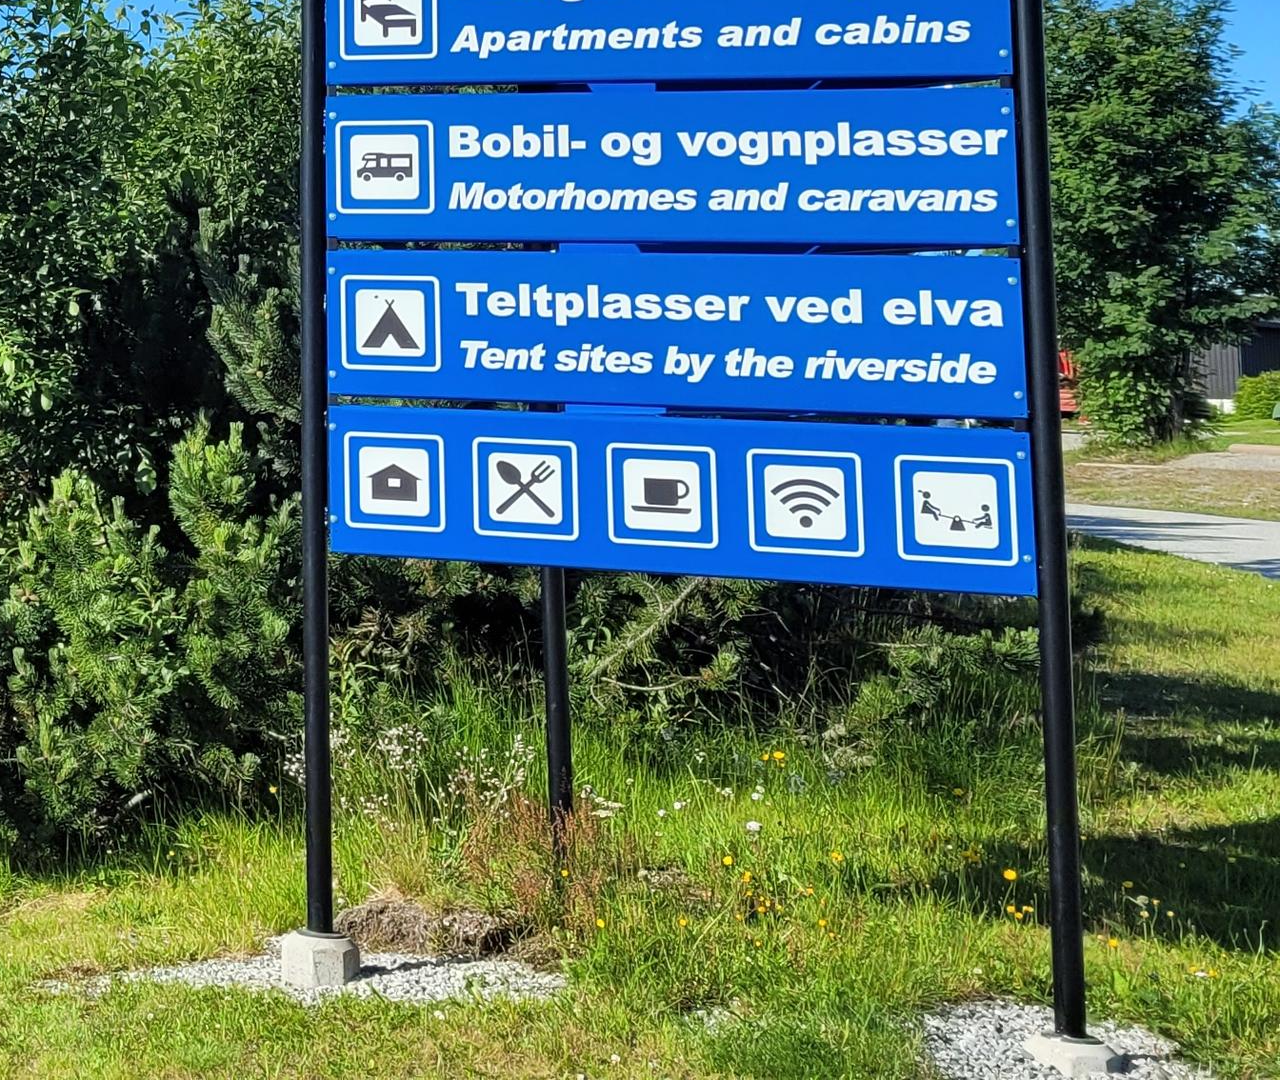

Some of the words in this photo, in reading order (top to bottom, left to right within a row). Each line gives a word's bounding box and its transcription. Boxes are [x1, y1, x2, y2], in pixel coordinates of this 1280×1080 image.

[449, 19, 703, 59] Apartments
[717, 17, 802, 48] and
[815, 14, 972, 46] cabins
[448, 124, 587, 158] Bobil-
[600, 131, 662, 167] og
[676, 121, 1008, 166] vognplasser
[448, 181, 697, 212] Motorhomes
[708, 182, 788, 212] and
[797, 188, 998, 212] caravans
[455, 282, 750, 327] Teltplasser
[764, 288, 864, 324] ved
[882, 289, 1005, 327] elva
[458, 340, 546, 371] Tent
[554, 343, 653, 374] sites
[662, 345, 716, 383] by
[724, 347, 794, 378] the
[804, 349, 998, 385] riverside
